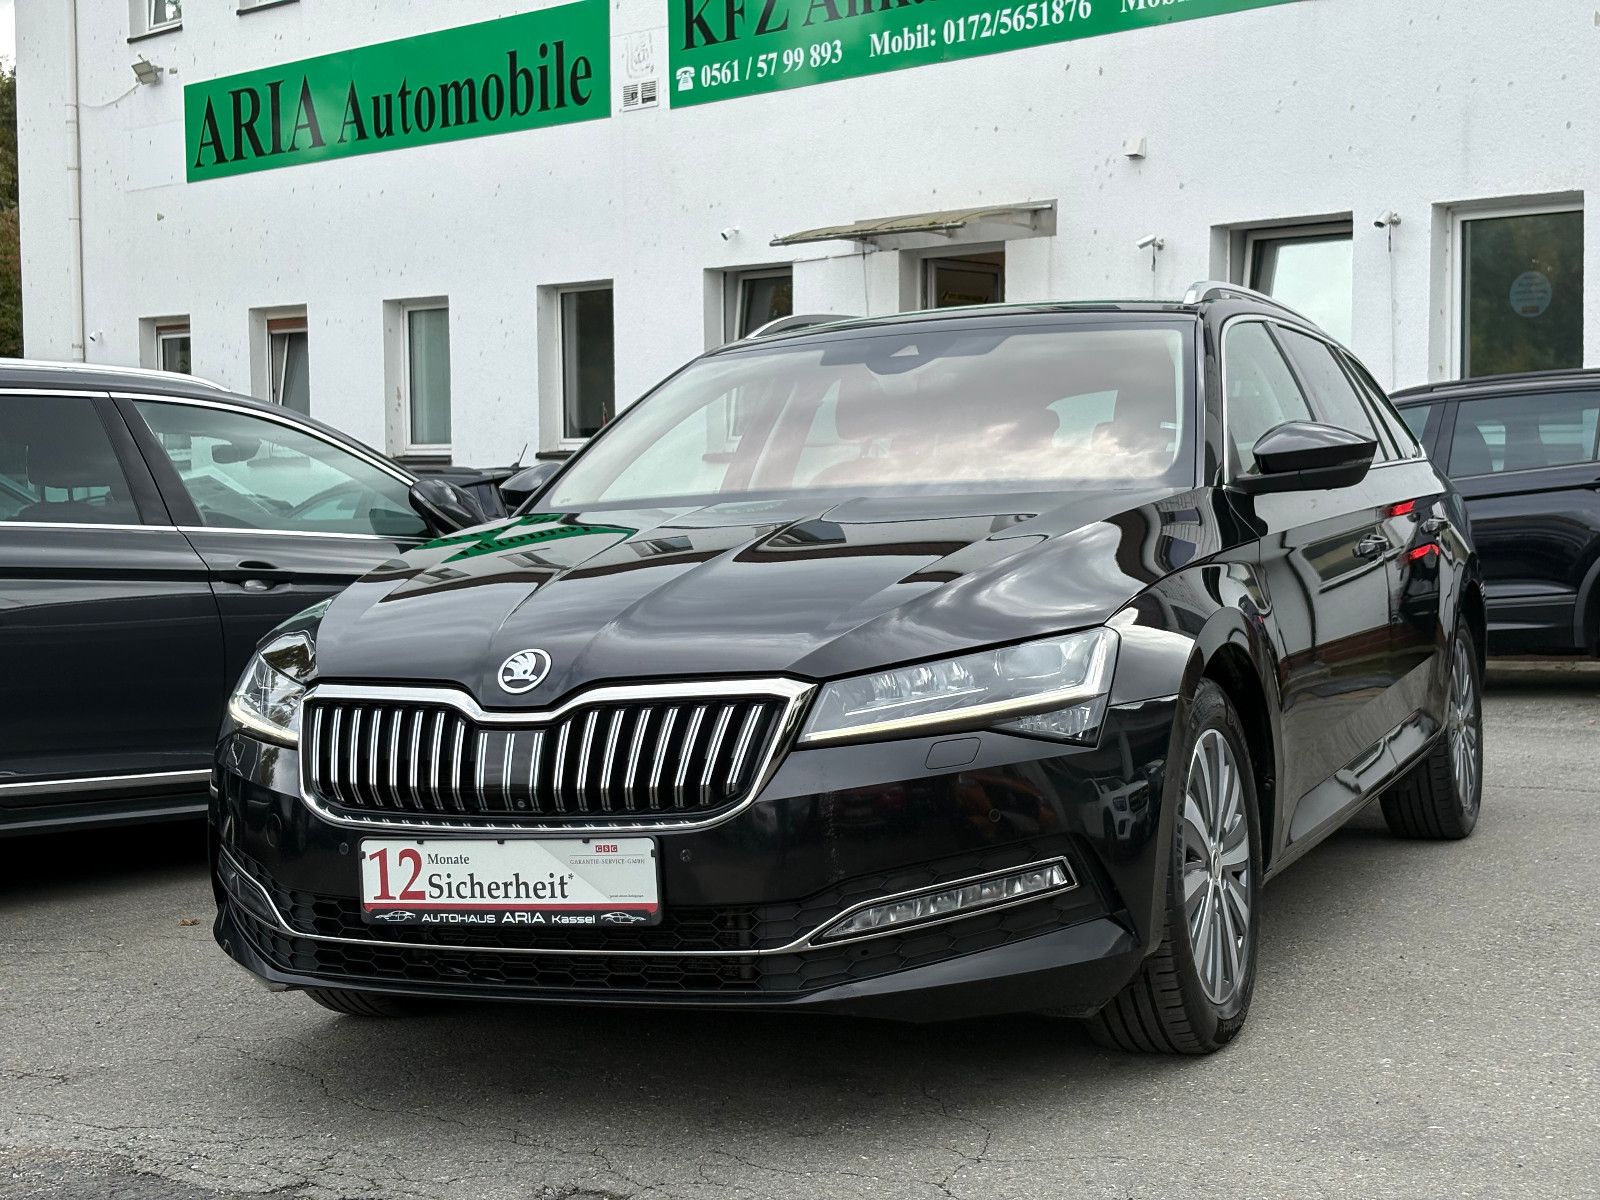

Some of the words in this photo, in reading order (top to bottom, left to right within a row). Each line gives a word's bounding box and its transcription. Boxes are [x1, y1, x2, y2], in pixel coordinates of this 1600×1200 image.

[681, 0, 790, 50] KFZ
[701, 59, 740, 87] 0561
[757, 52, 777, 77] 57
[783, 48, 804, 73] 99
[810, 40, 842, 67] 893
[869, 24, 936, 57] Mobil:
[943, 0, 1092, 44] 0172/5651876
[194, 74, 326, 168] ARIA
[337, 40, 593, 144] Automobile
[369, 848, 426, 900] 12
[427, 853, 470, 865] Monate
[422, 913, 496, 924] AUTOHAUS
[502, 911, 546, 924] ARIA
[551, 914, 596, 924] Kassel
